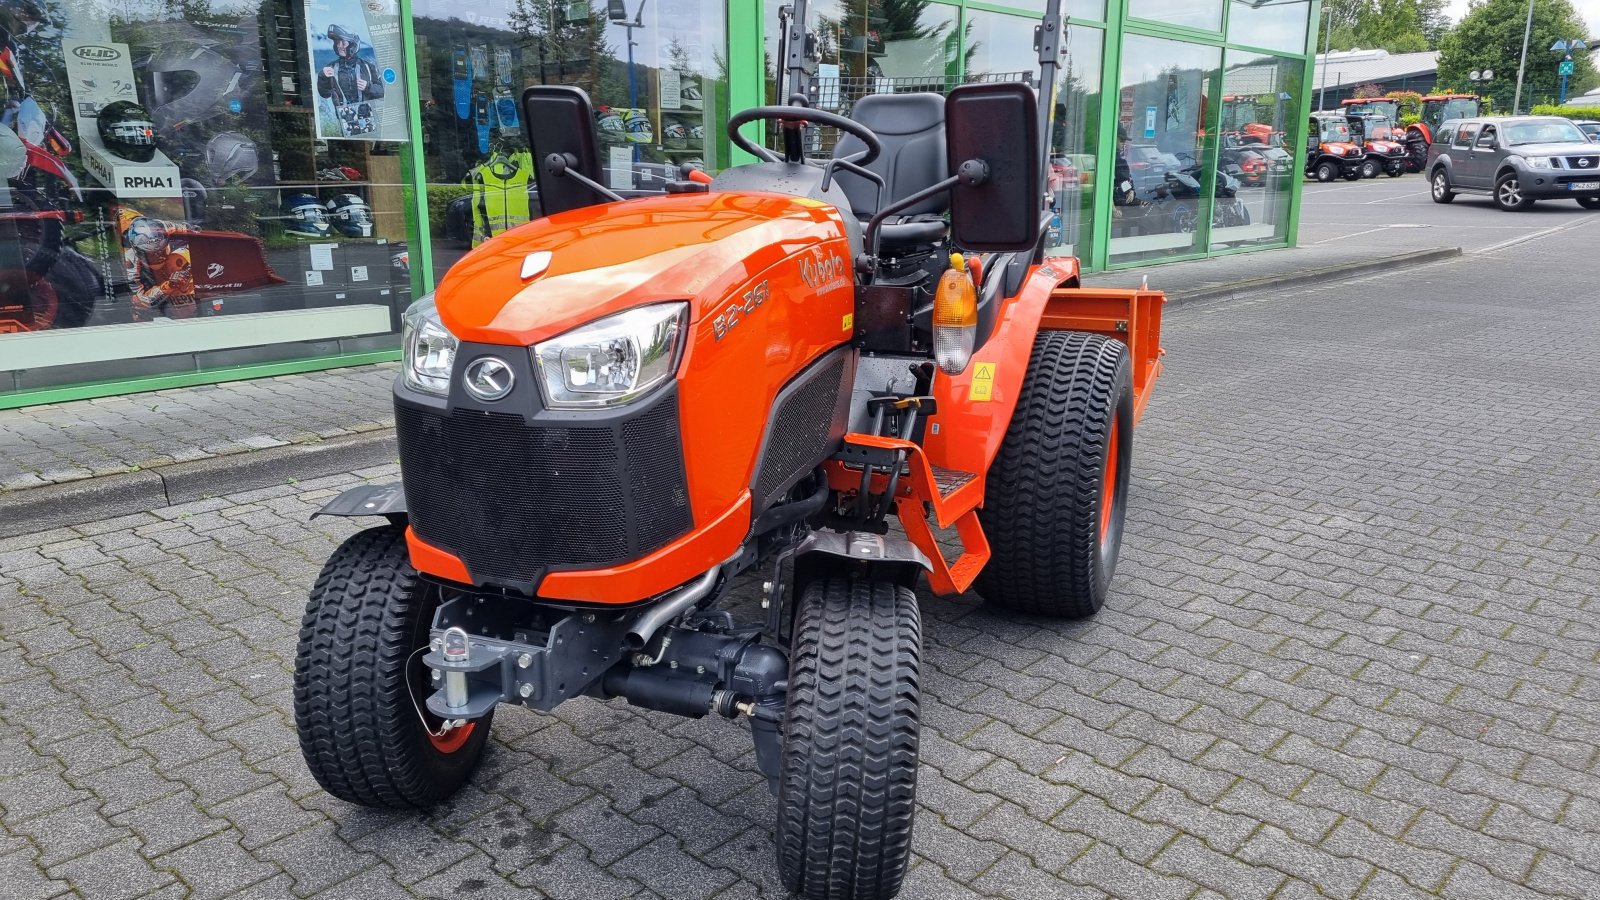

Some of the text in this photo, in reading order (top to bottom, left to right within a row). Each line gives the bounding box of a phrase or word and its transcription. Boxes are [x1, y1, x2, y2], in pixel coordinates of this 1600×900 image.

[79, 48, 115, 58] HJC
[90, 155, 112, 183] RPHA 1
[123, 177, 173, 188] RPHA 1
[799, 249, 845, 288] Kubota
[712, 279, 770, 343] B2-261
